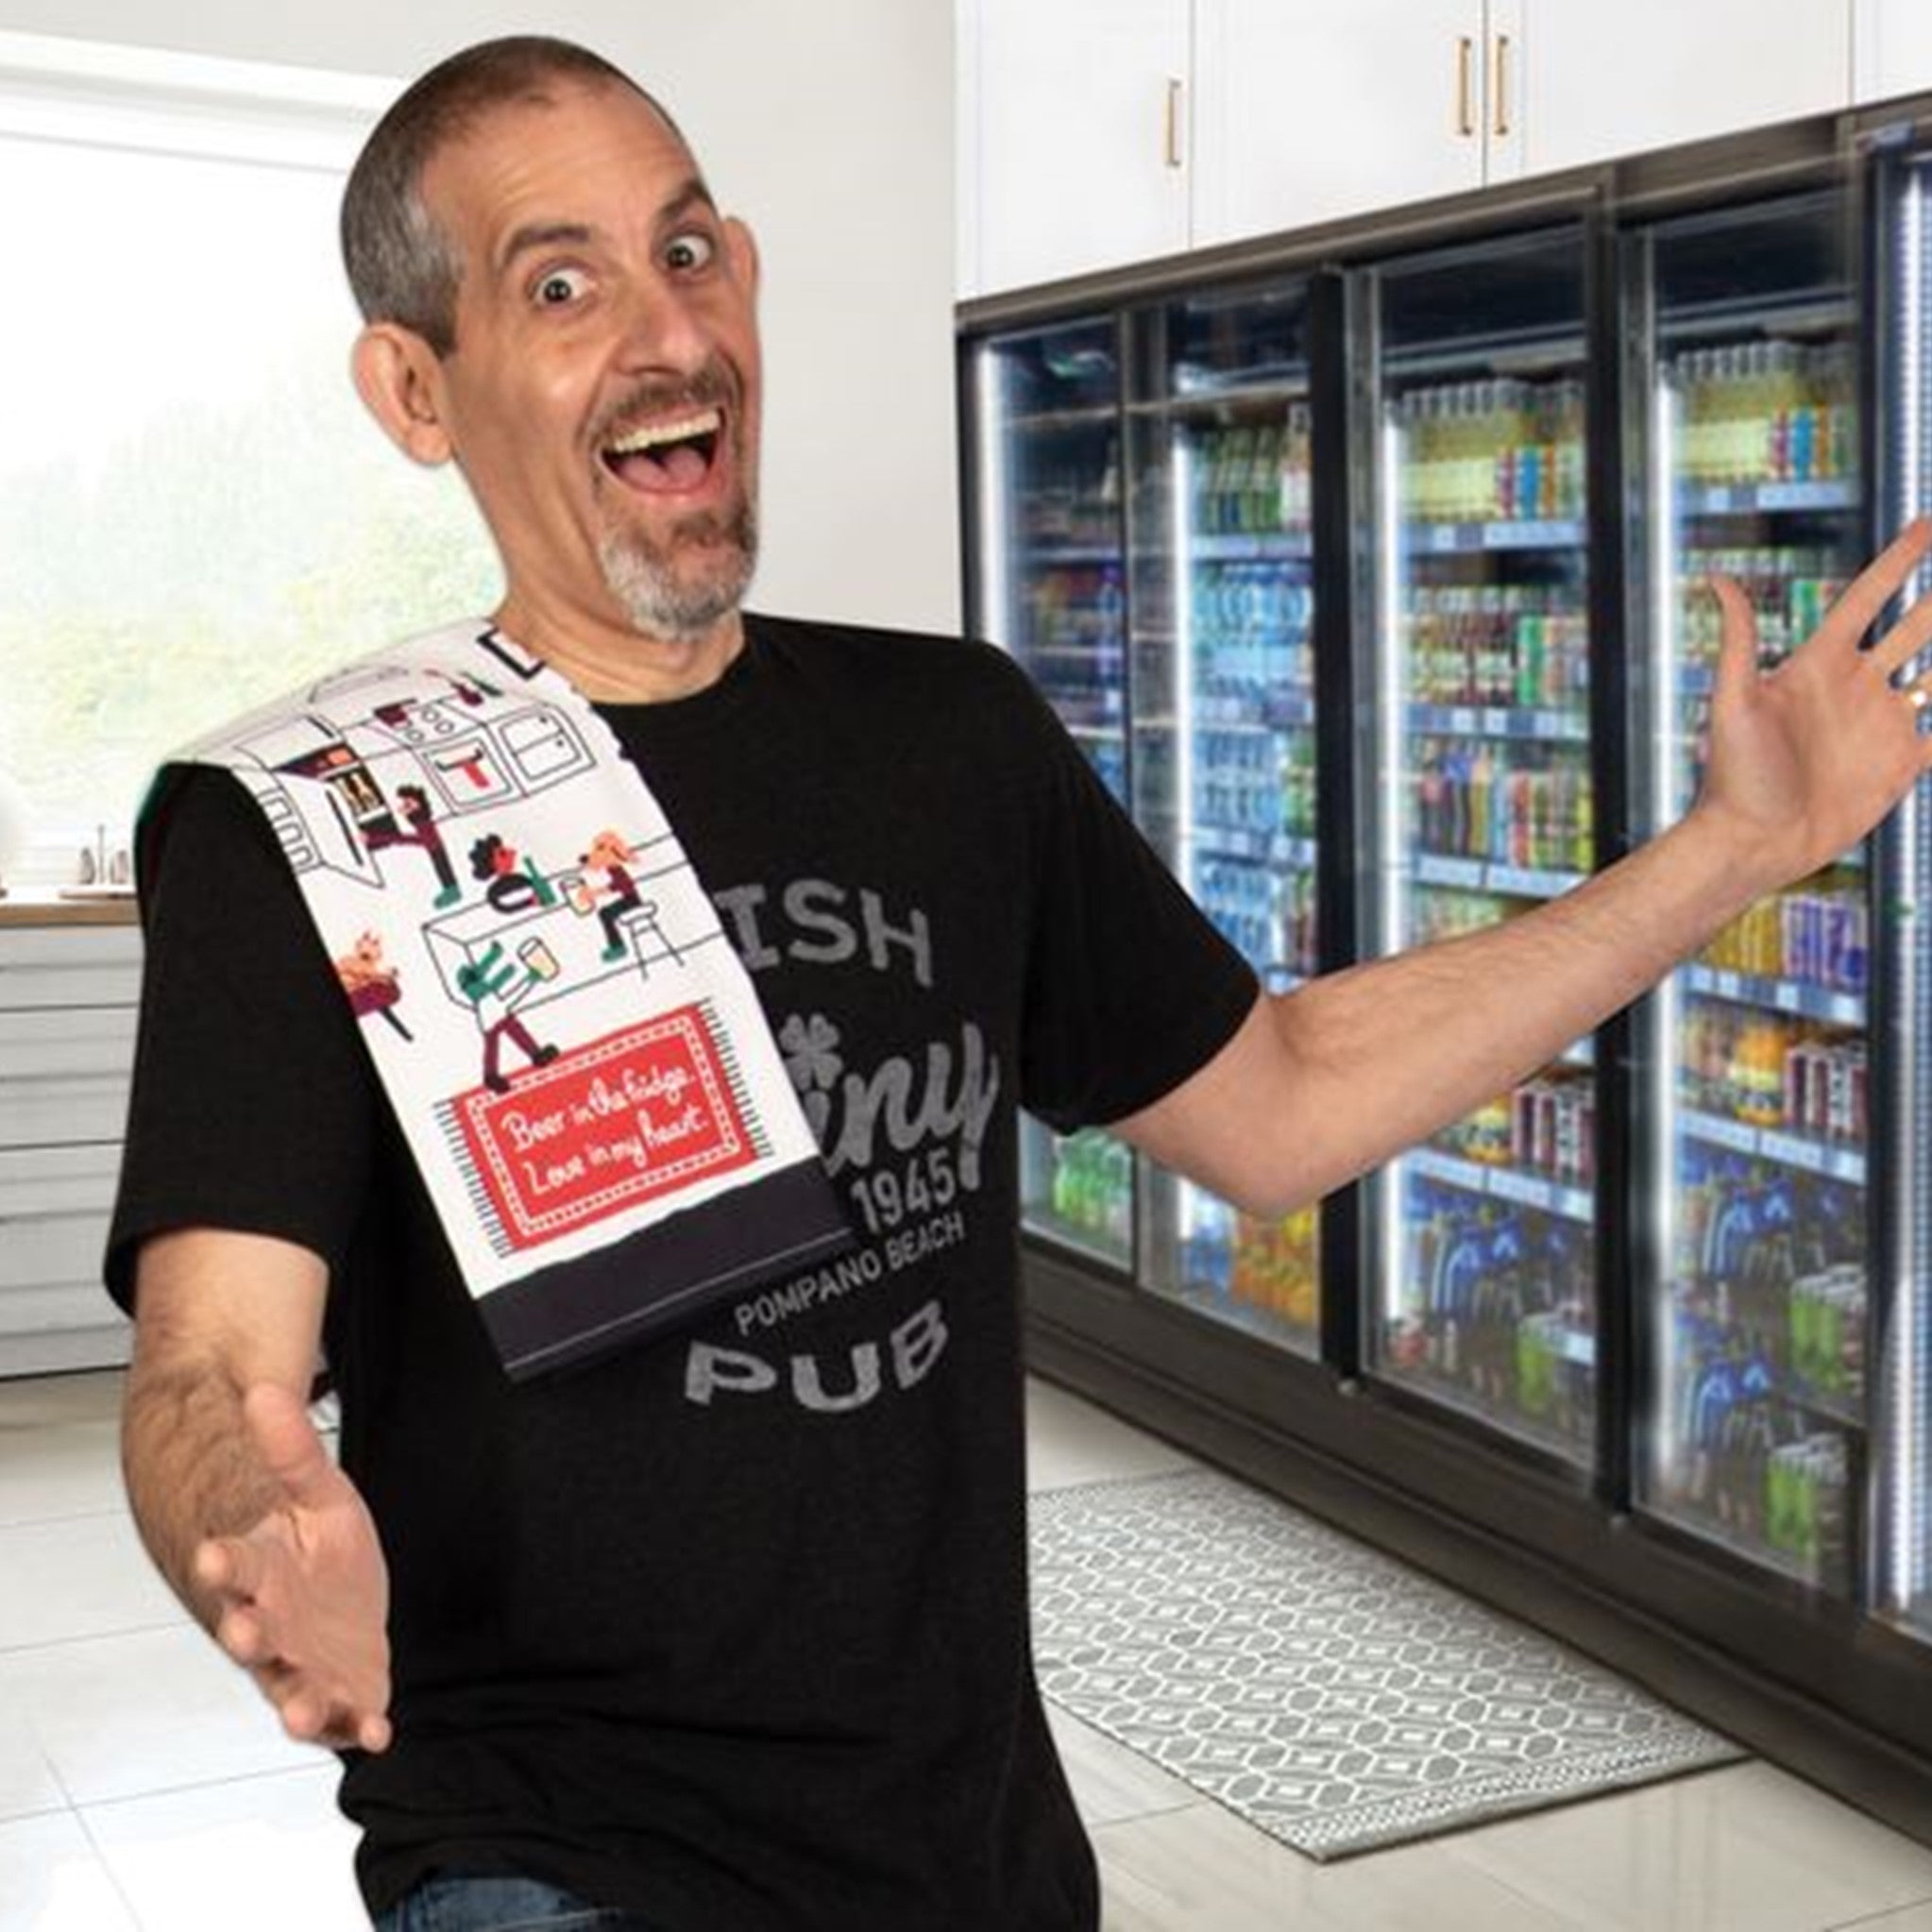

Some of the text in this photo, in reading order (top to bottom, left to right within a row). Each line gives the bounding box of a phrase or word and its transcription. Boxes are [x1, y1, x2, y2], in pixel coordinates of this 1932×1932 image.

[714, 879, 933, 988] ISH
[501, 1110, 566, 1153] Beer
[568, 1103, 595, 1126] in
[588, 1076, 630, 1116] the
[803, 1022, 1000, 1192] iny
[522, 1154, 587, 1196] Love
[584, 1142, 610, 1167] in
[609, 1134, 648, 1169] my
[852, 1145, 957, 1234] 1945
[734, 1211, 967, 1337] POMPANO BEACH
[685, 1300, 949, 1412] PUB
